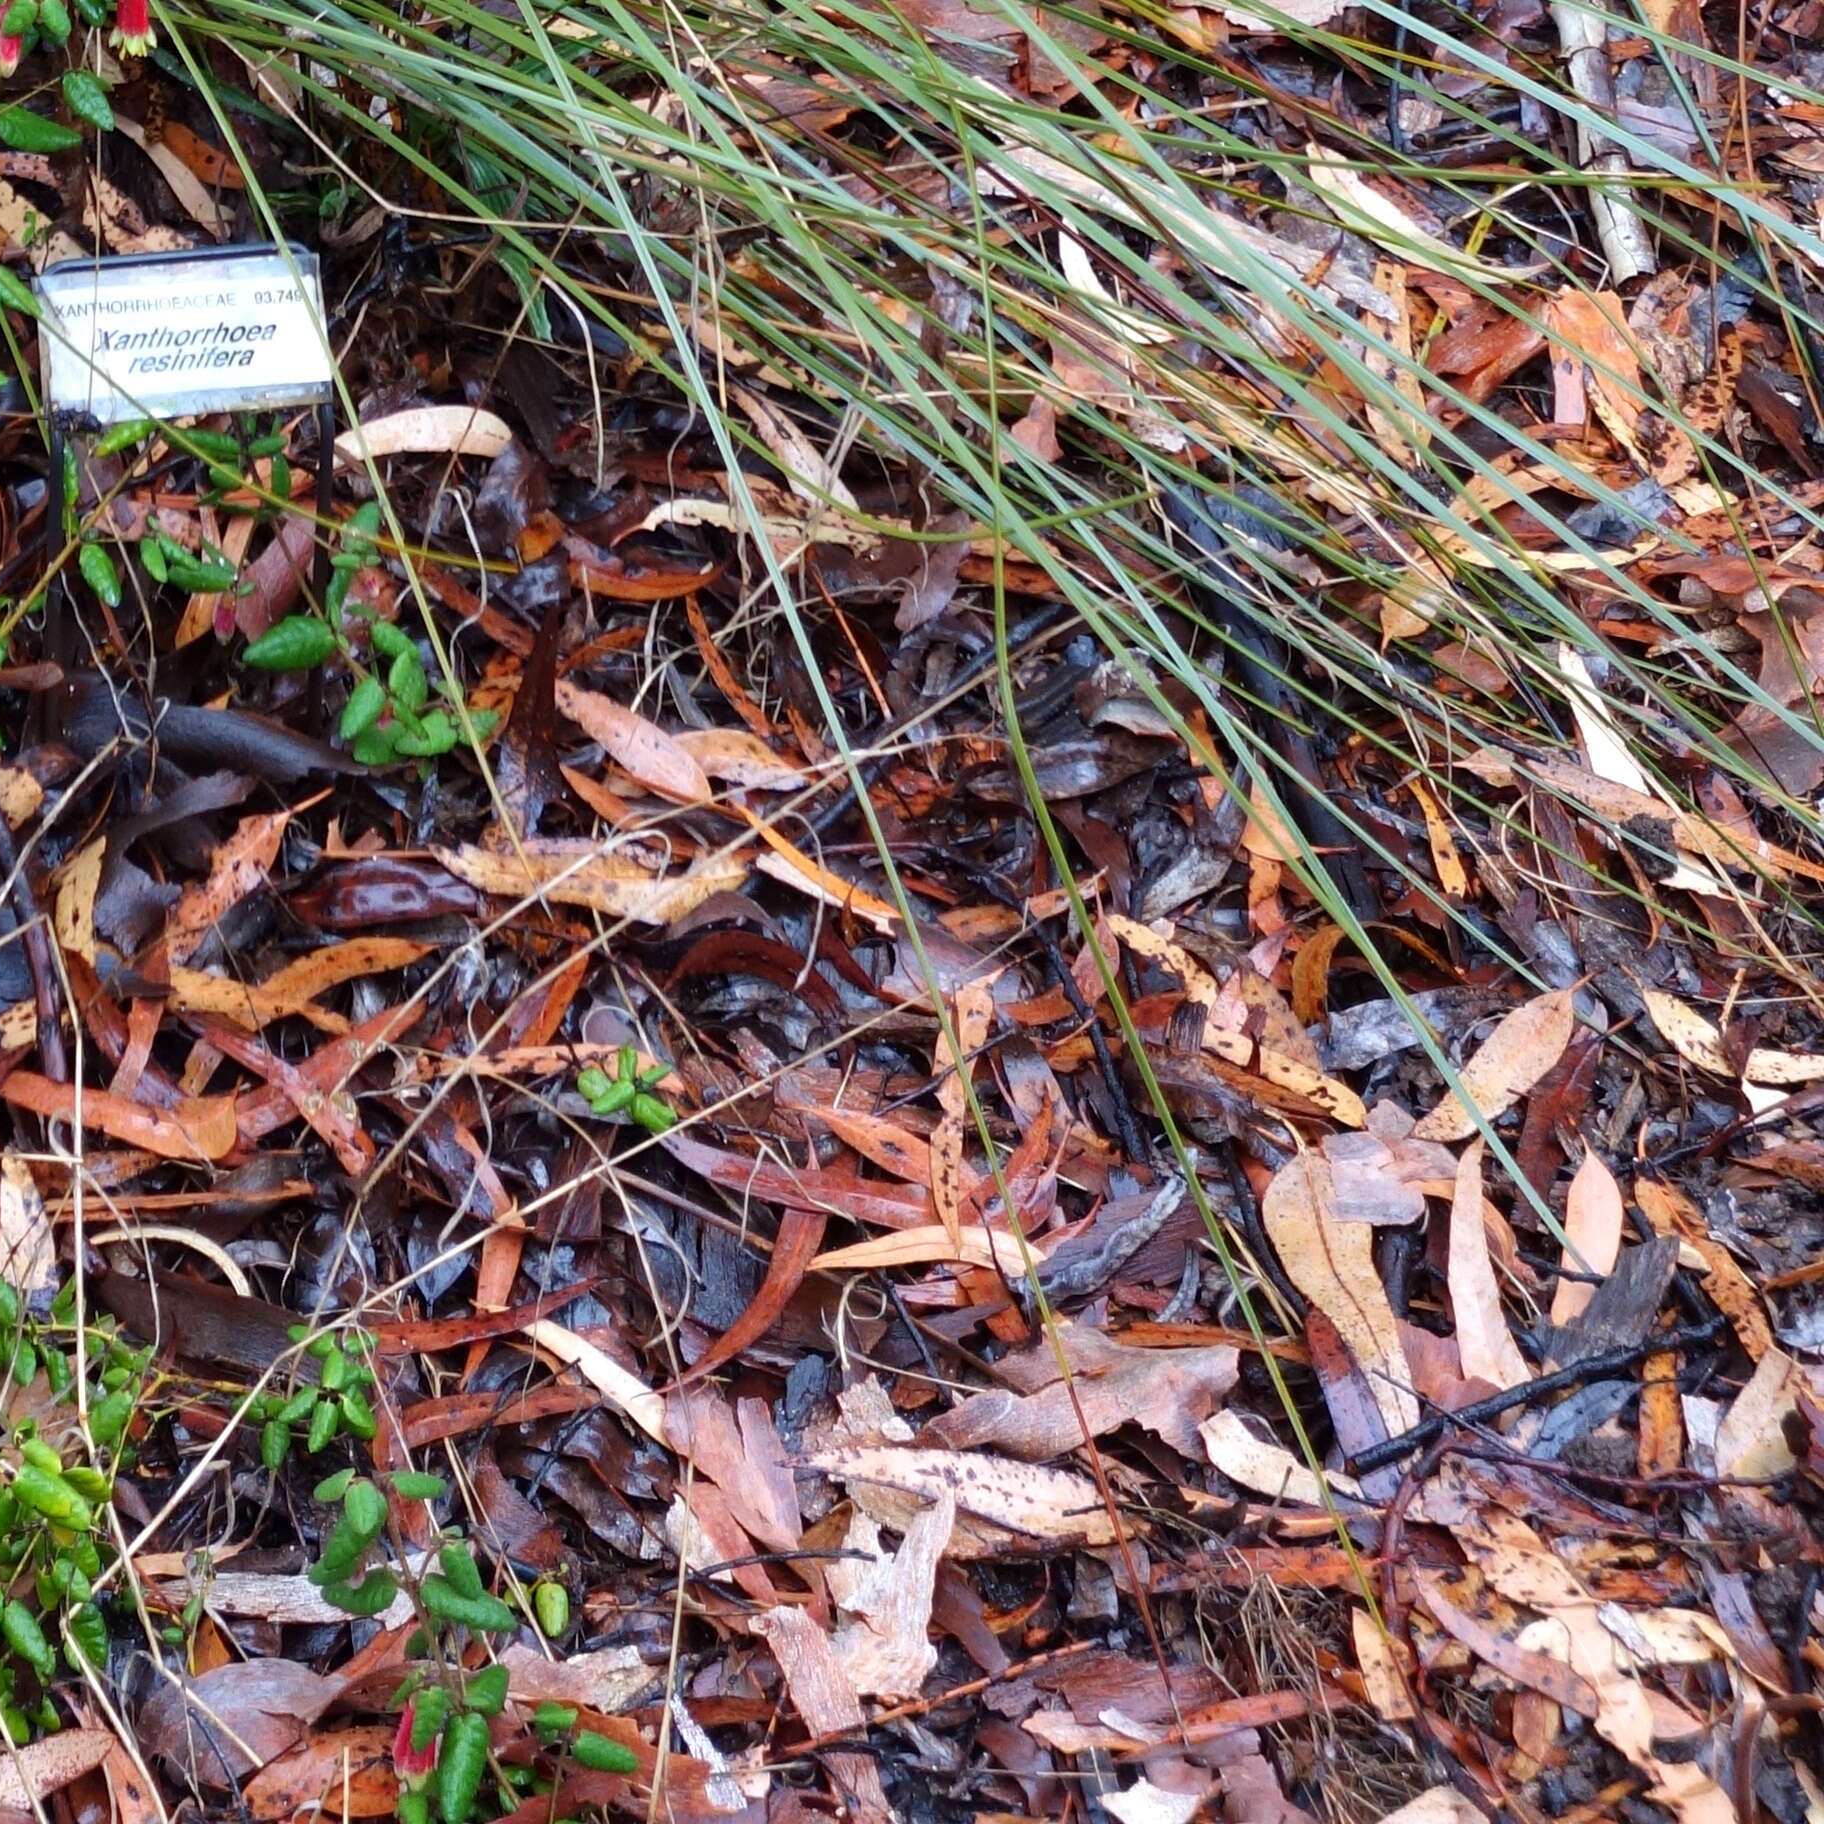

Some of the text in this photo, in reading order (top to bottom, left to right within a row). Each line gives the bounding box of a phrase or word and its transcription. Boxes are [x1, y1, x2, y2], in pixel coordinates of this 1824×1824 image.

[55, 291, 237, 319] XANTHORRHOEACEAE
[95, 321, 277, 353] Xanthorrhoea
[128, 346, 255, 375] resinifera
